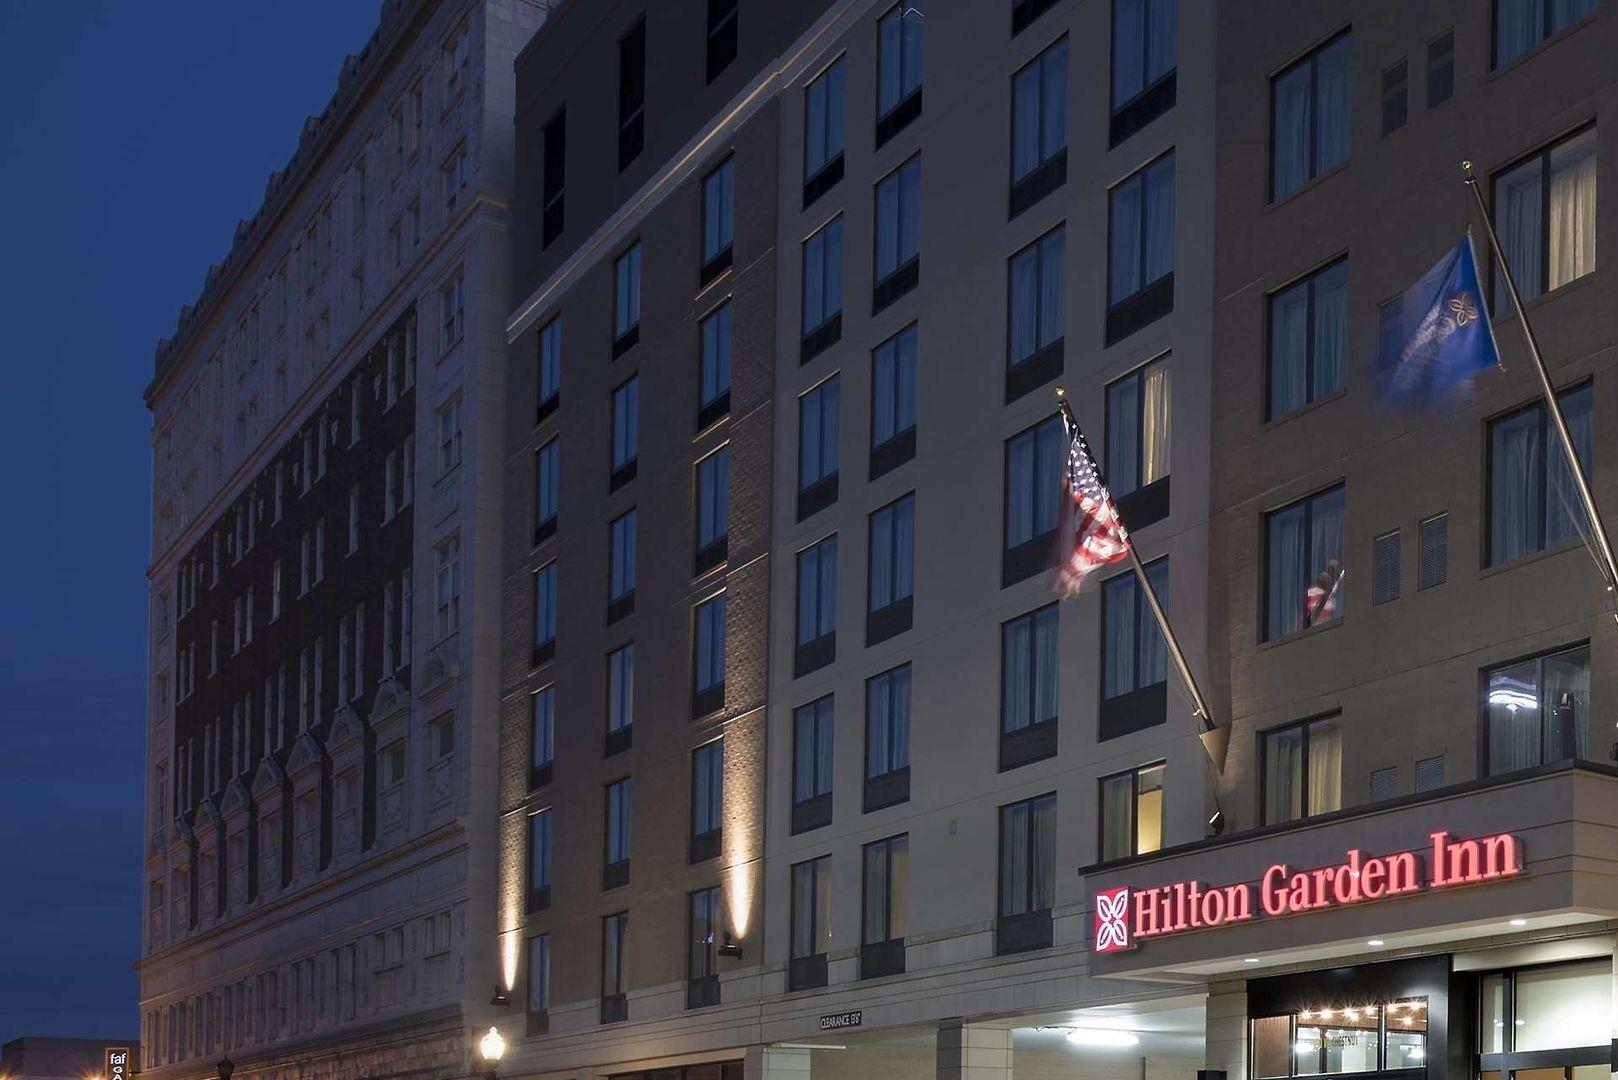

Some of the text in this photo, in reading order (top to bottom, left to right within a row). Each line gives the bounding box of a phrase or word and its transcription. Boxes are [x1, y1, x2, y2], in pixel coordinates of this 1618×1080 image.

[1133, 831, 1518, 938] Hilton Garden Inn
[821, 1014, 850, 1029] CLEARANCE
[110, 1053, 126, 1065] faf
